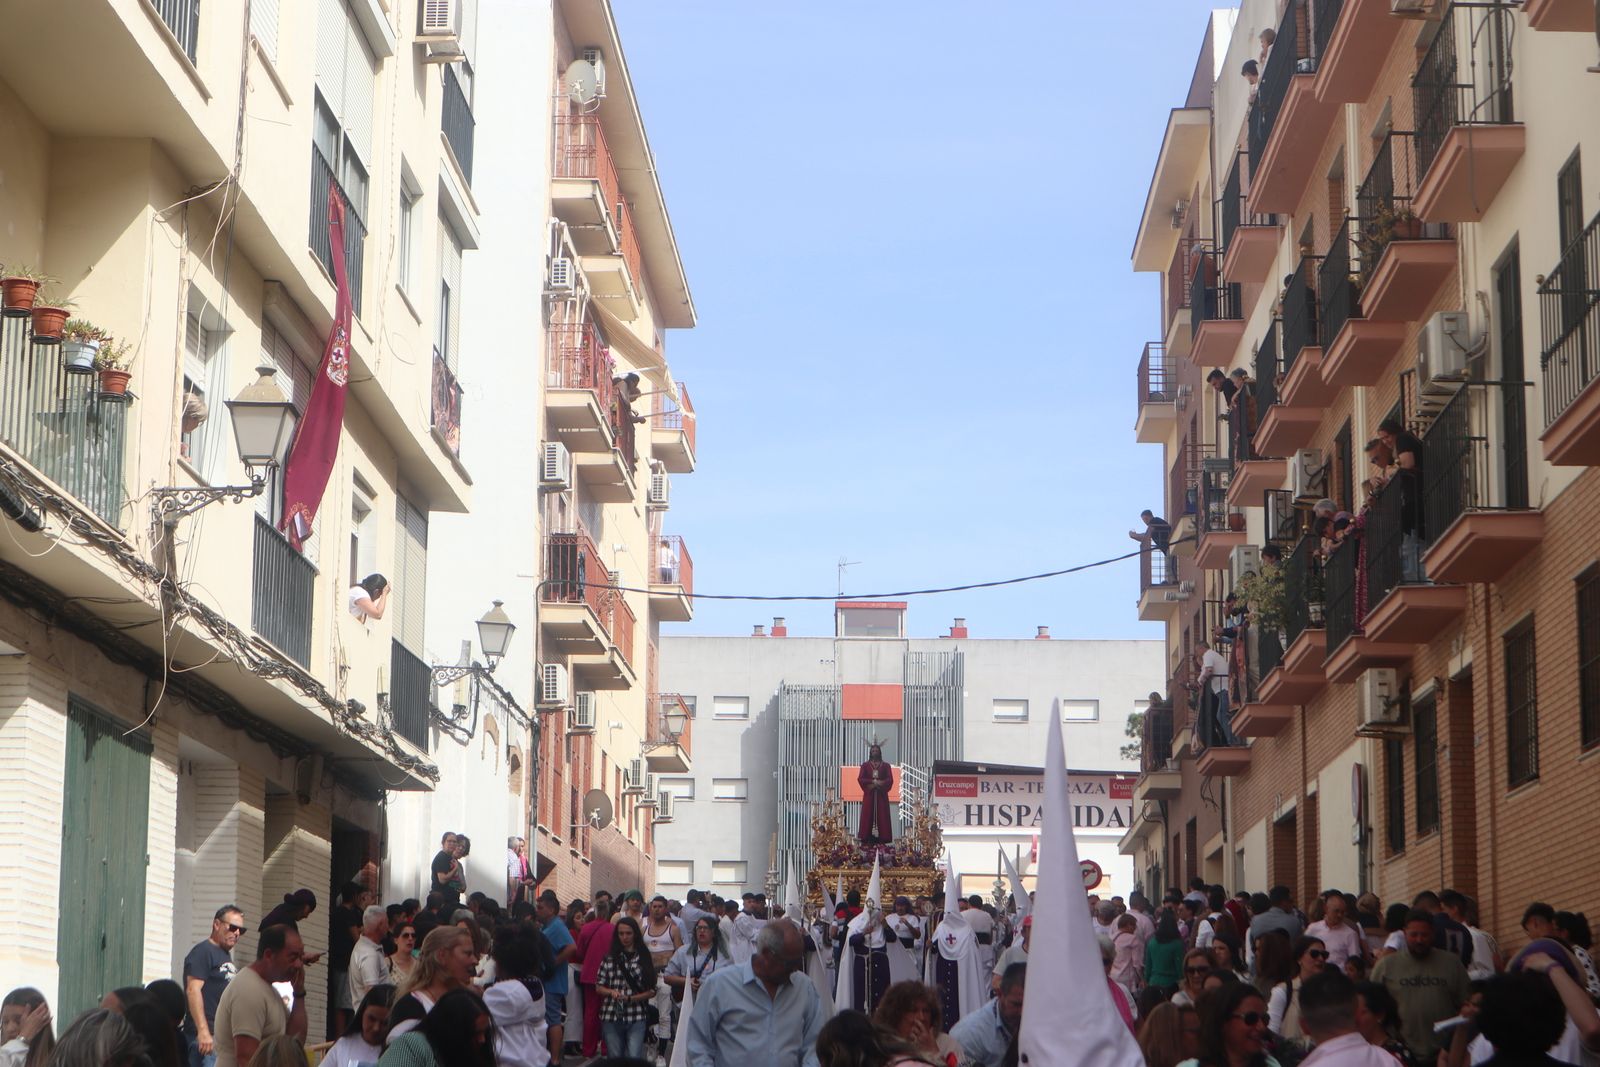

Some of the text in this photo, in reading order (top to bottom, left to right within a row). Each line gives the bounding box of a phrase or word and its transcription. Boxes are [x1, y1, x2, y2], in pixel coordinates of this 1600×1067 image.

[938, 780, 975, 789] Cruzcampo
[980, 781, 1015, 793] BAR
[1019, 782, 1106, 794] -TEAZA
[964, 804, 1133, 828] HISPAIDA
